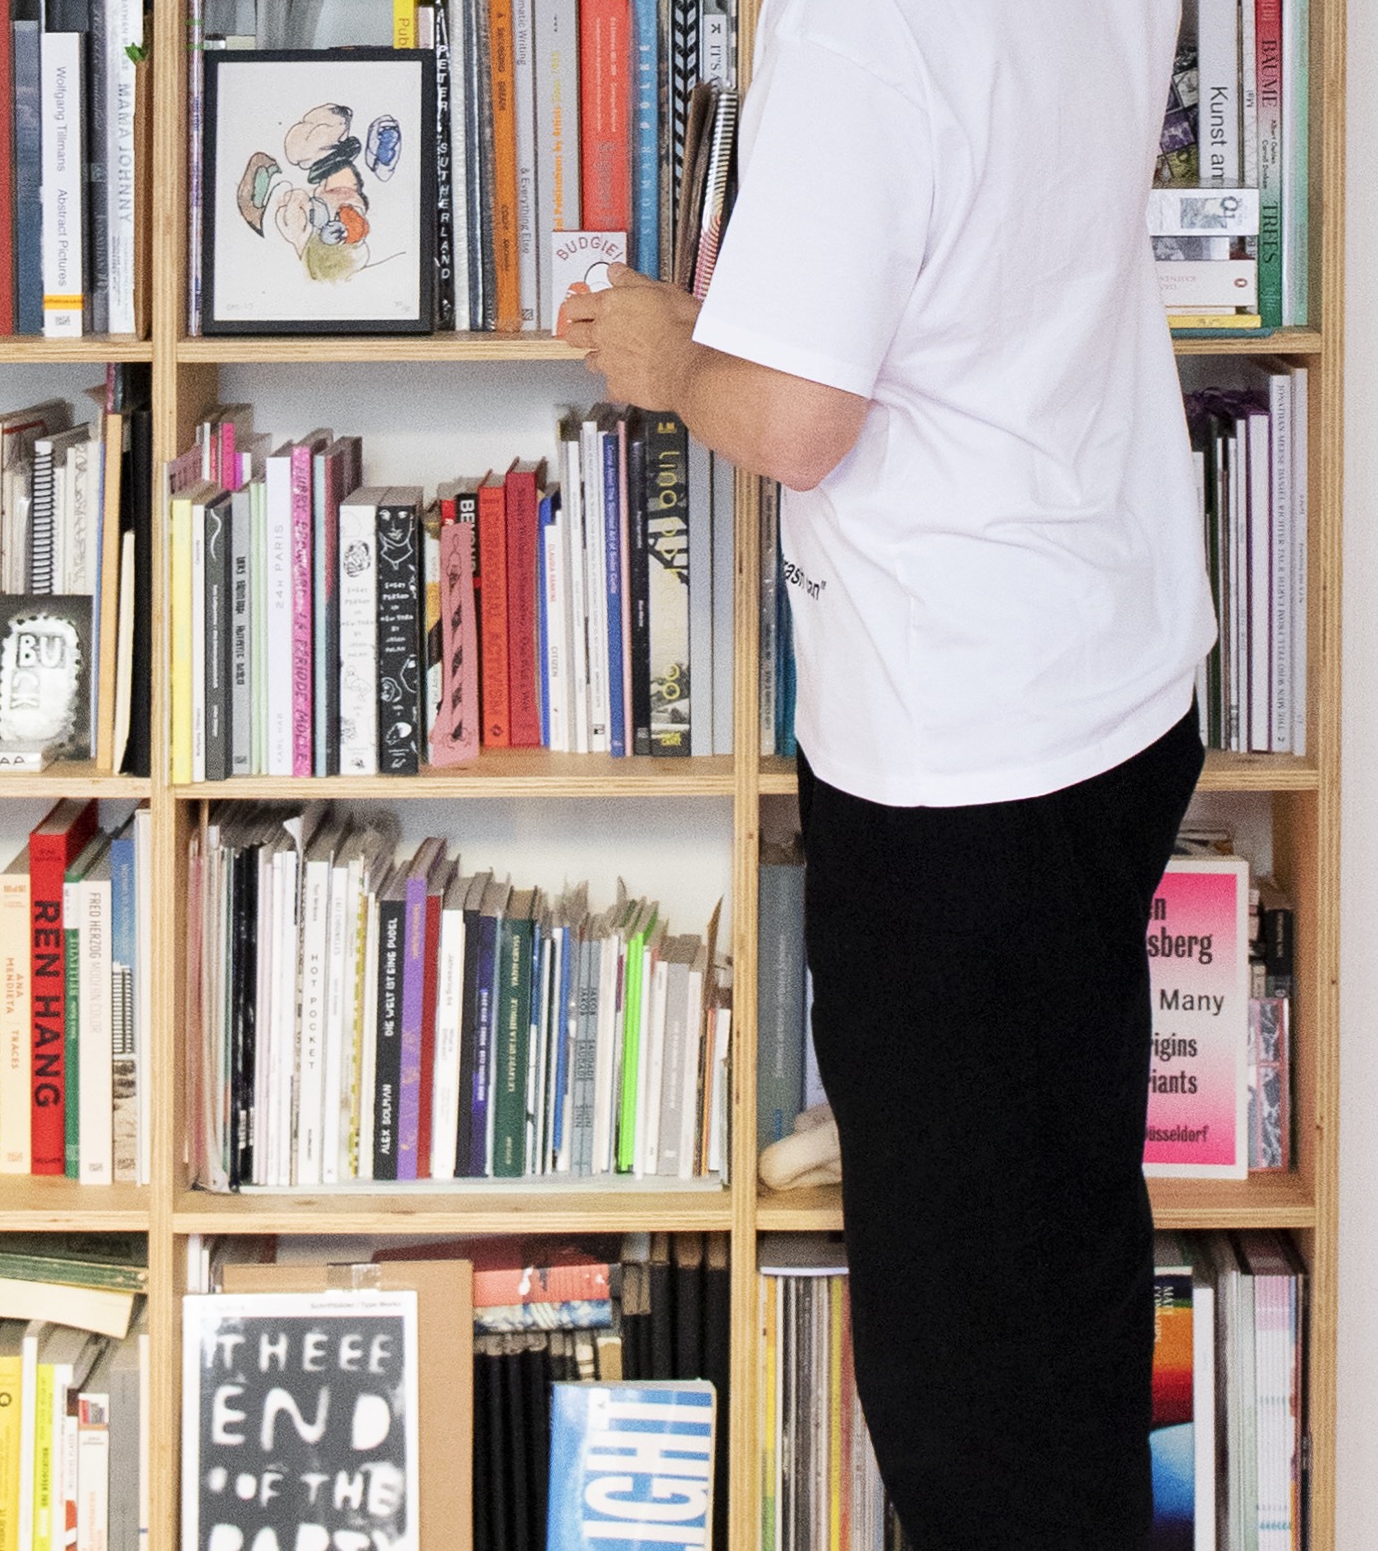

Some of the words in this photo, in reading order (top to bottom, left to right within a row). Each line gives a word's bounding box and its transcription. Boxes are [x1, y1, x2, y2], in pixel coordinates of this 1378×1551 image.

[54, 66, 68, 120] Wolfgang
[118, 83, 131, 138] MAMA
[1210, 85, 1229, 147] Kunst
[56, 124, 68, 172] Tillmans
[57, 188, 69, 236] Abstract
[1262, 200, 1279, 264] TREES
[58, 240, 69, 287] Pictures
[34, 900, 61, 978] REN
[1159, 989, 1225, 1016] Many
[34, 996, 61, 1108] HANG
[211, 1383, 393, 1451] END
